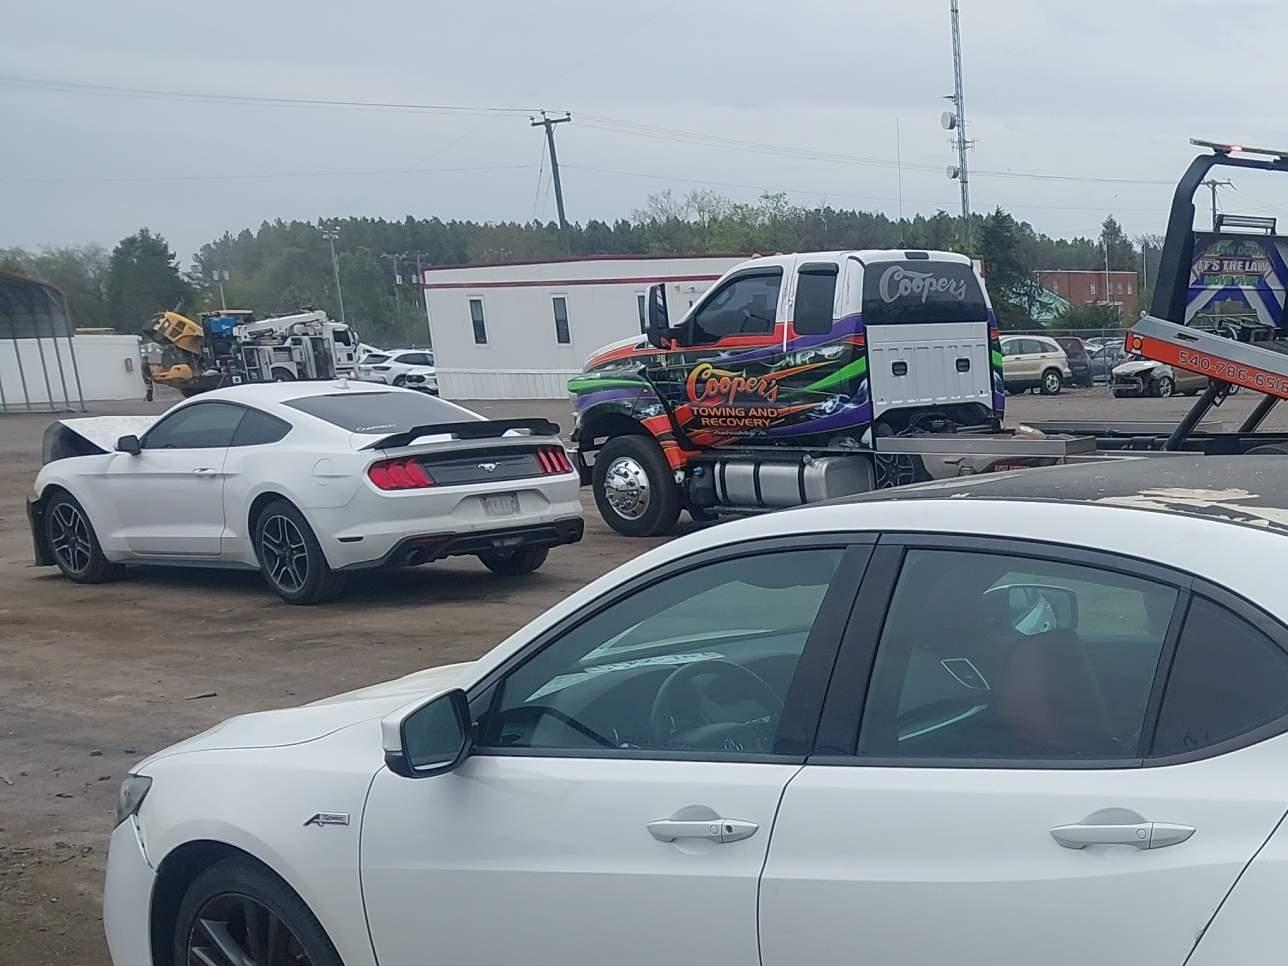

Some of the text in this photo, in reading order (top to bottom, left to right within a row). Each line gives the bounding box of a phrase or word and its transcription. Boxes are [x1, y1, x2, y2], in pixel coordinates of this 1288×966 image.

[1198, 260, 1270, 271] IT'S THE LAW
[879, 265, 967, 304] Cooper's
[686, 363, 779, 406] Cooper's
[691, 406, 778, 417] TOWING AND
[701, 417, 771, 427] RECOVERY
